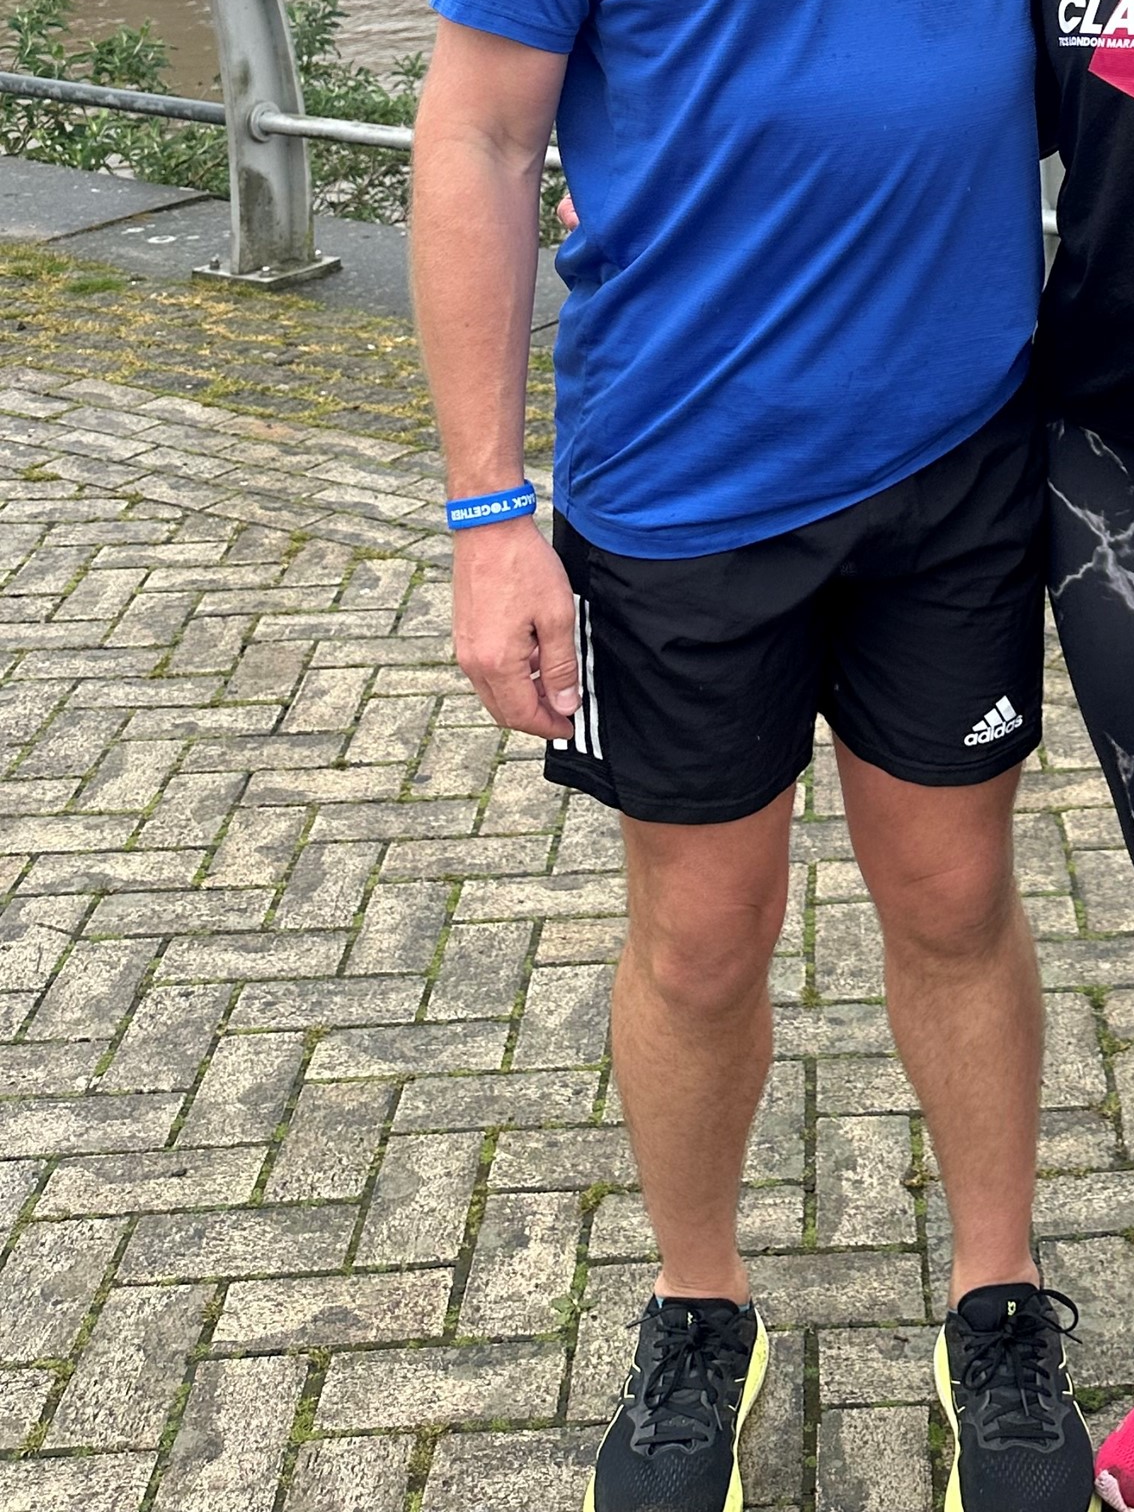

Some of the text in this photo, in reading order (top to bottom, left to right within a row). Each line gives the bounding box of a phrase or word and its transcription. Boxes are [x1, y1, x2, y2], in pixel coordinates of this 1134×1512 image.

[1068, 37, 1106, 48] LONDON
[450, 500, 511, 521] TOGETHER
[964, 714, 1023, 746] adidas
